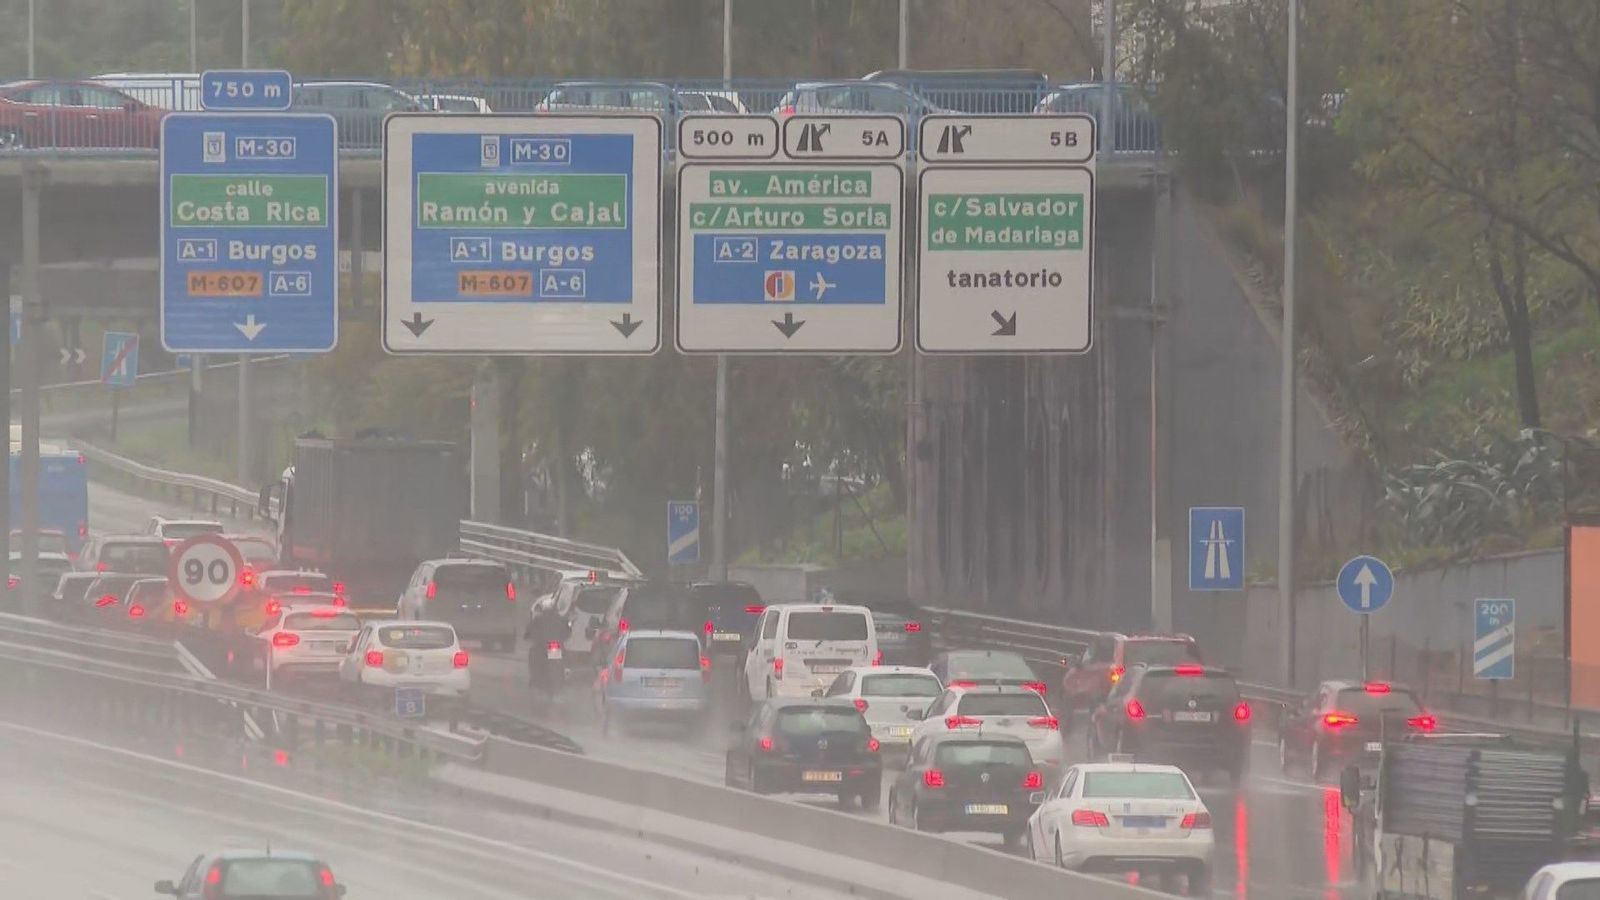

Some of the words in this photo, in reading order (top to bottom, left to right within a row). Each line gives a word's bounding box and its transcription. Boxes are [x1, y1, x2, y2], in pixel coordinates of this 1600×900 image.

[212, 82, 254, 97] 750
[264, 85, 281, 97] m
[693, 130, 733, 145] 500
[748, 133, 763, 145] m
[862, 131, 889, 146] 5A
[1051, 132, 1078, 147] 5B
[239, 140, 292, 156] M-30
[515, 143, 567, 160] M-30
[226, 181, 273, 196] calle
[486, 179, 560, 194] avenida
[713, 180, 750, 194] av.
[766, 174, 868, 194] América
[178, 202, 250, 221] Costa
[267, 202, 320, 221] Rica
[423, 201, 508, 222] Ramón
[523, 207, 534, 225] y
[551, 202, 622, 225] Cajal
[935, 198, 1078, 216] c/Salvador
[693, 207, 805, 227] c/Arturo
[824, 206, 888, 226] Soria
[932, 227, 958, 243] de
[966, 226, 1080, 247] Madariaga
[182, 242, 215, 258] A-1
[229, 241, 317, 265] Burgos
[455, 242, 488, 257] A-1
[502, 242, 594, 265] Burgos
[720, 242, 754, 258] A-2
[770, 241, 882, 263] Zaragoza
[191, 276, 258, 292] M-607
[275, 276, 307, 292] A-6
[462, 276, 528, 292] M-607
[545, 275, 582, 291] A-6
[948, 269, 1063, 288] tanatorio
[184, 558, 229, 585] 90
